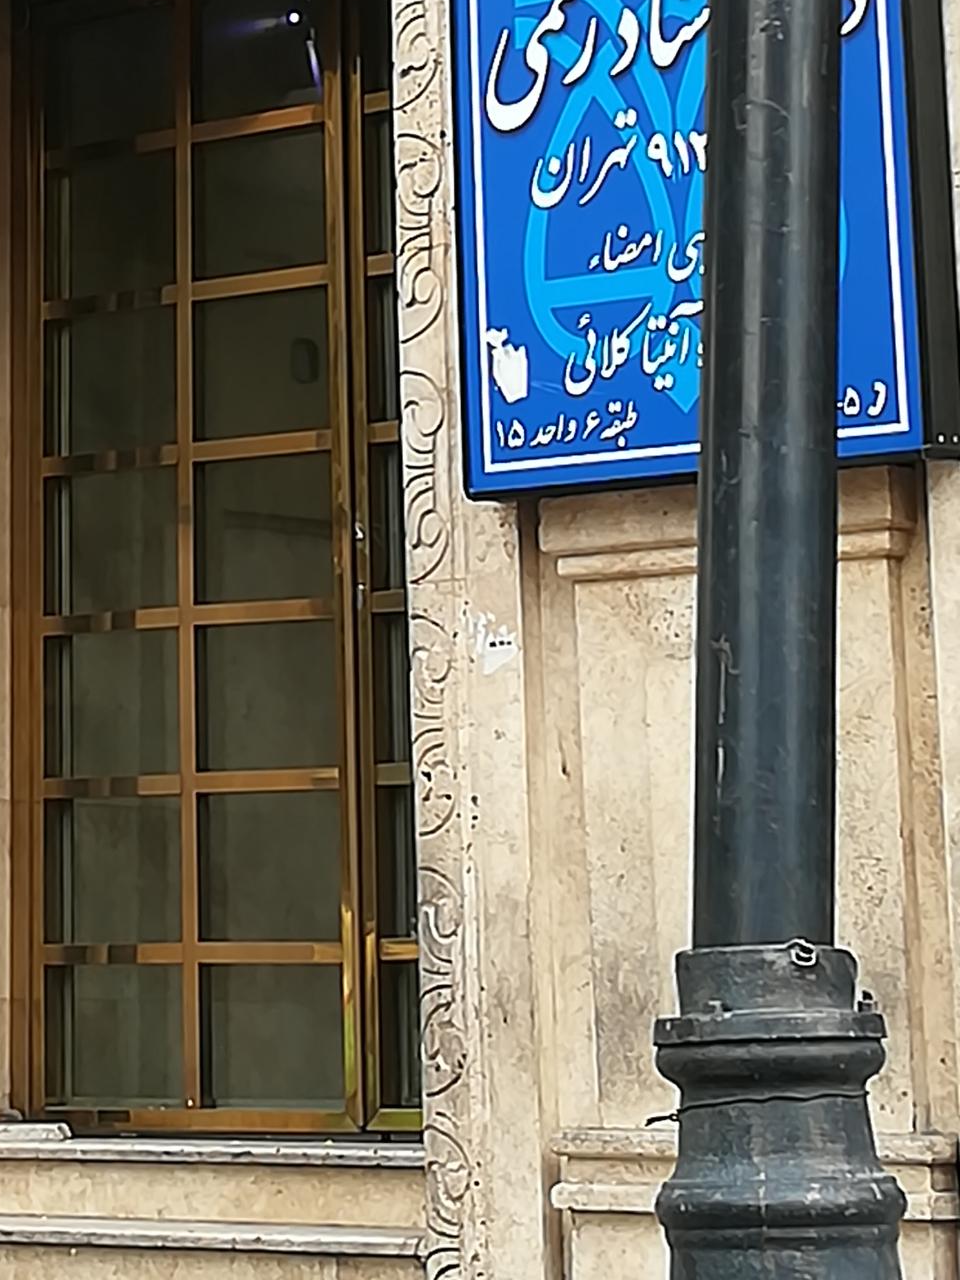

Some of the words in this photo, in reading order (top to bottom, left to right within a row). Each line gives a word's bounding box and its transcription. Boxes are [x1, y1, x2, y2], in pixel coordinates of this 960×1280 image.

[528, 108, 638, 208] تهران
[496, 420, 526, 449] ۱۵
[529, 413, 578, 447] واحد
